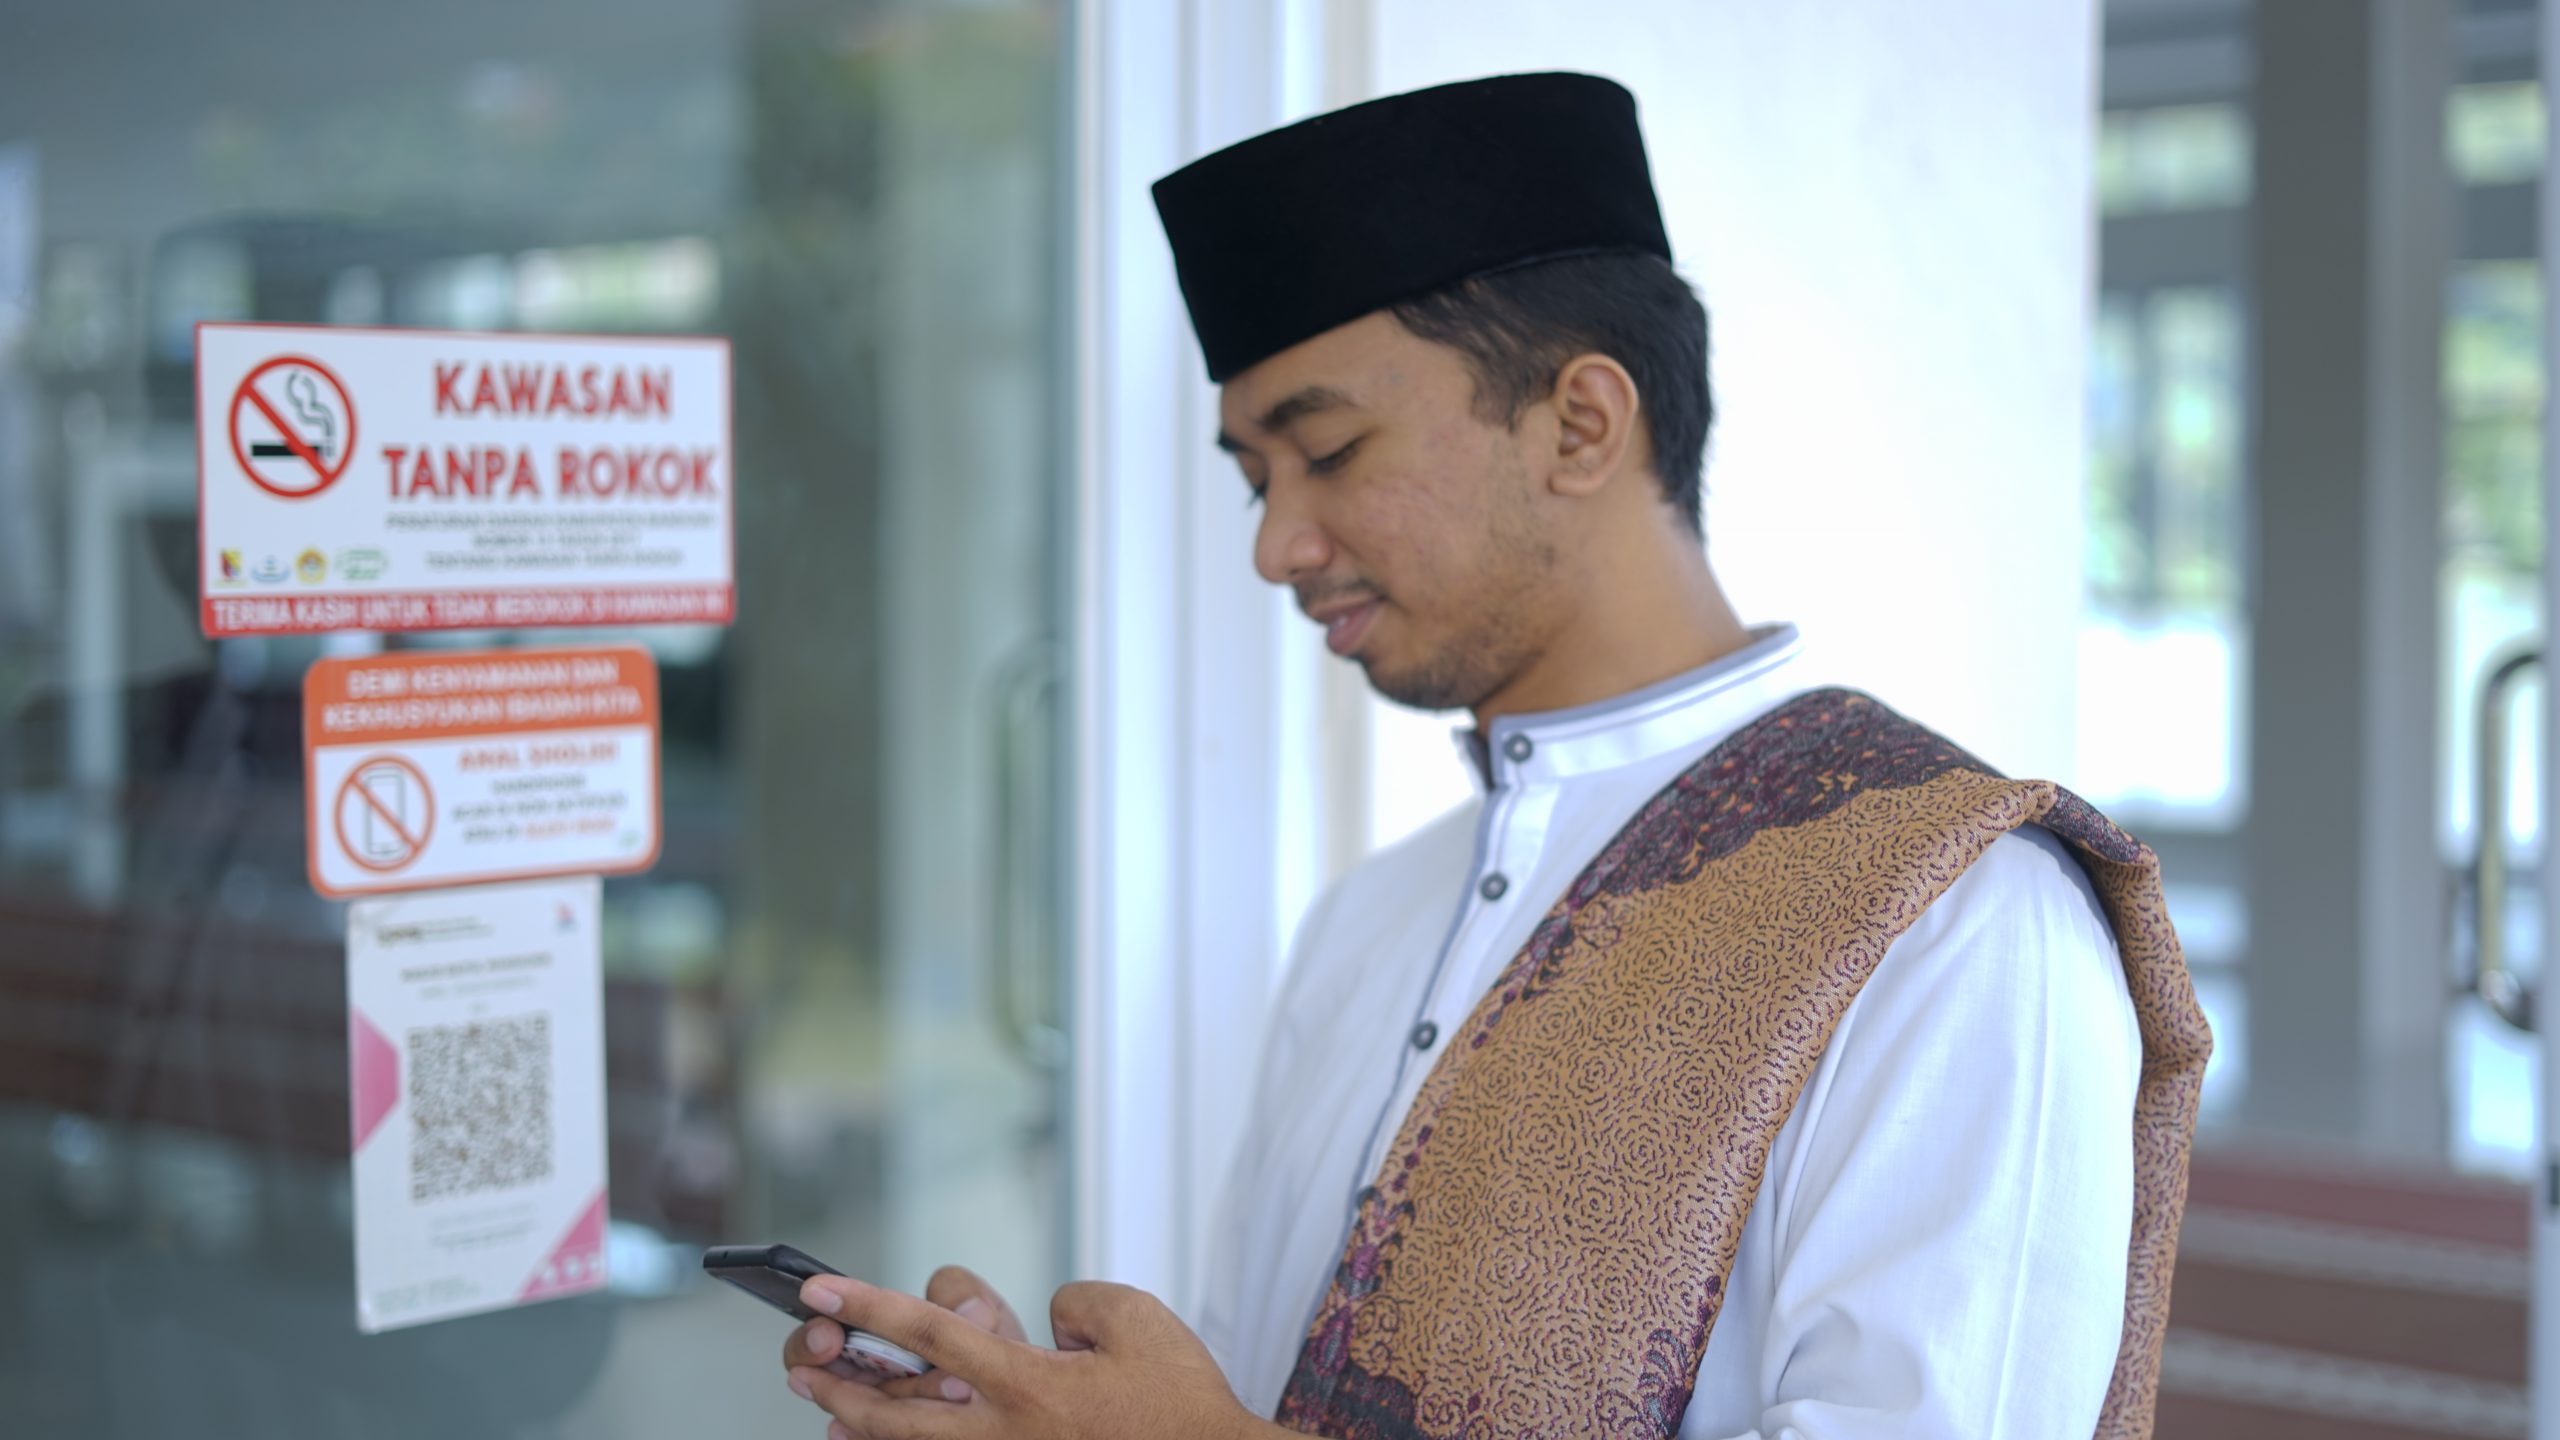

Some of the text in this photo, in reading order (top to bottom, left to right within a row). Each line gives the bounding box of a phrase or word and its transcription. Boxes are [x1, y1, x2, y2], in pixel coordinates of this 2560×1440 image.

[434, 363, 671, 416] KAWASAN
[383, 446, 717, 498] TANPA ROKOK
[214, 601, 291, 630] TERIMA
[296, 598, 356, 627] KASIH
[362, 597, 429, 626] UNTUK
[432, 595, 488, 624] TIDAK
[496, 594, 585, 622] MEROKOK
[347, 658, 620, 697] DEMI KENYAMANAN DAN
[322, 697, 501, 731] KEKHUSYUKAN
